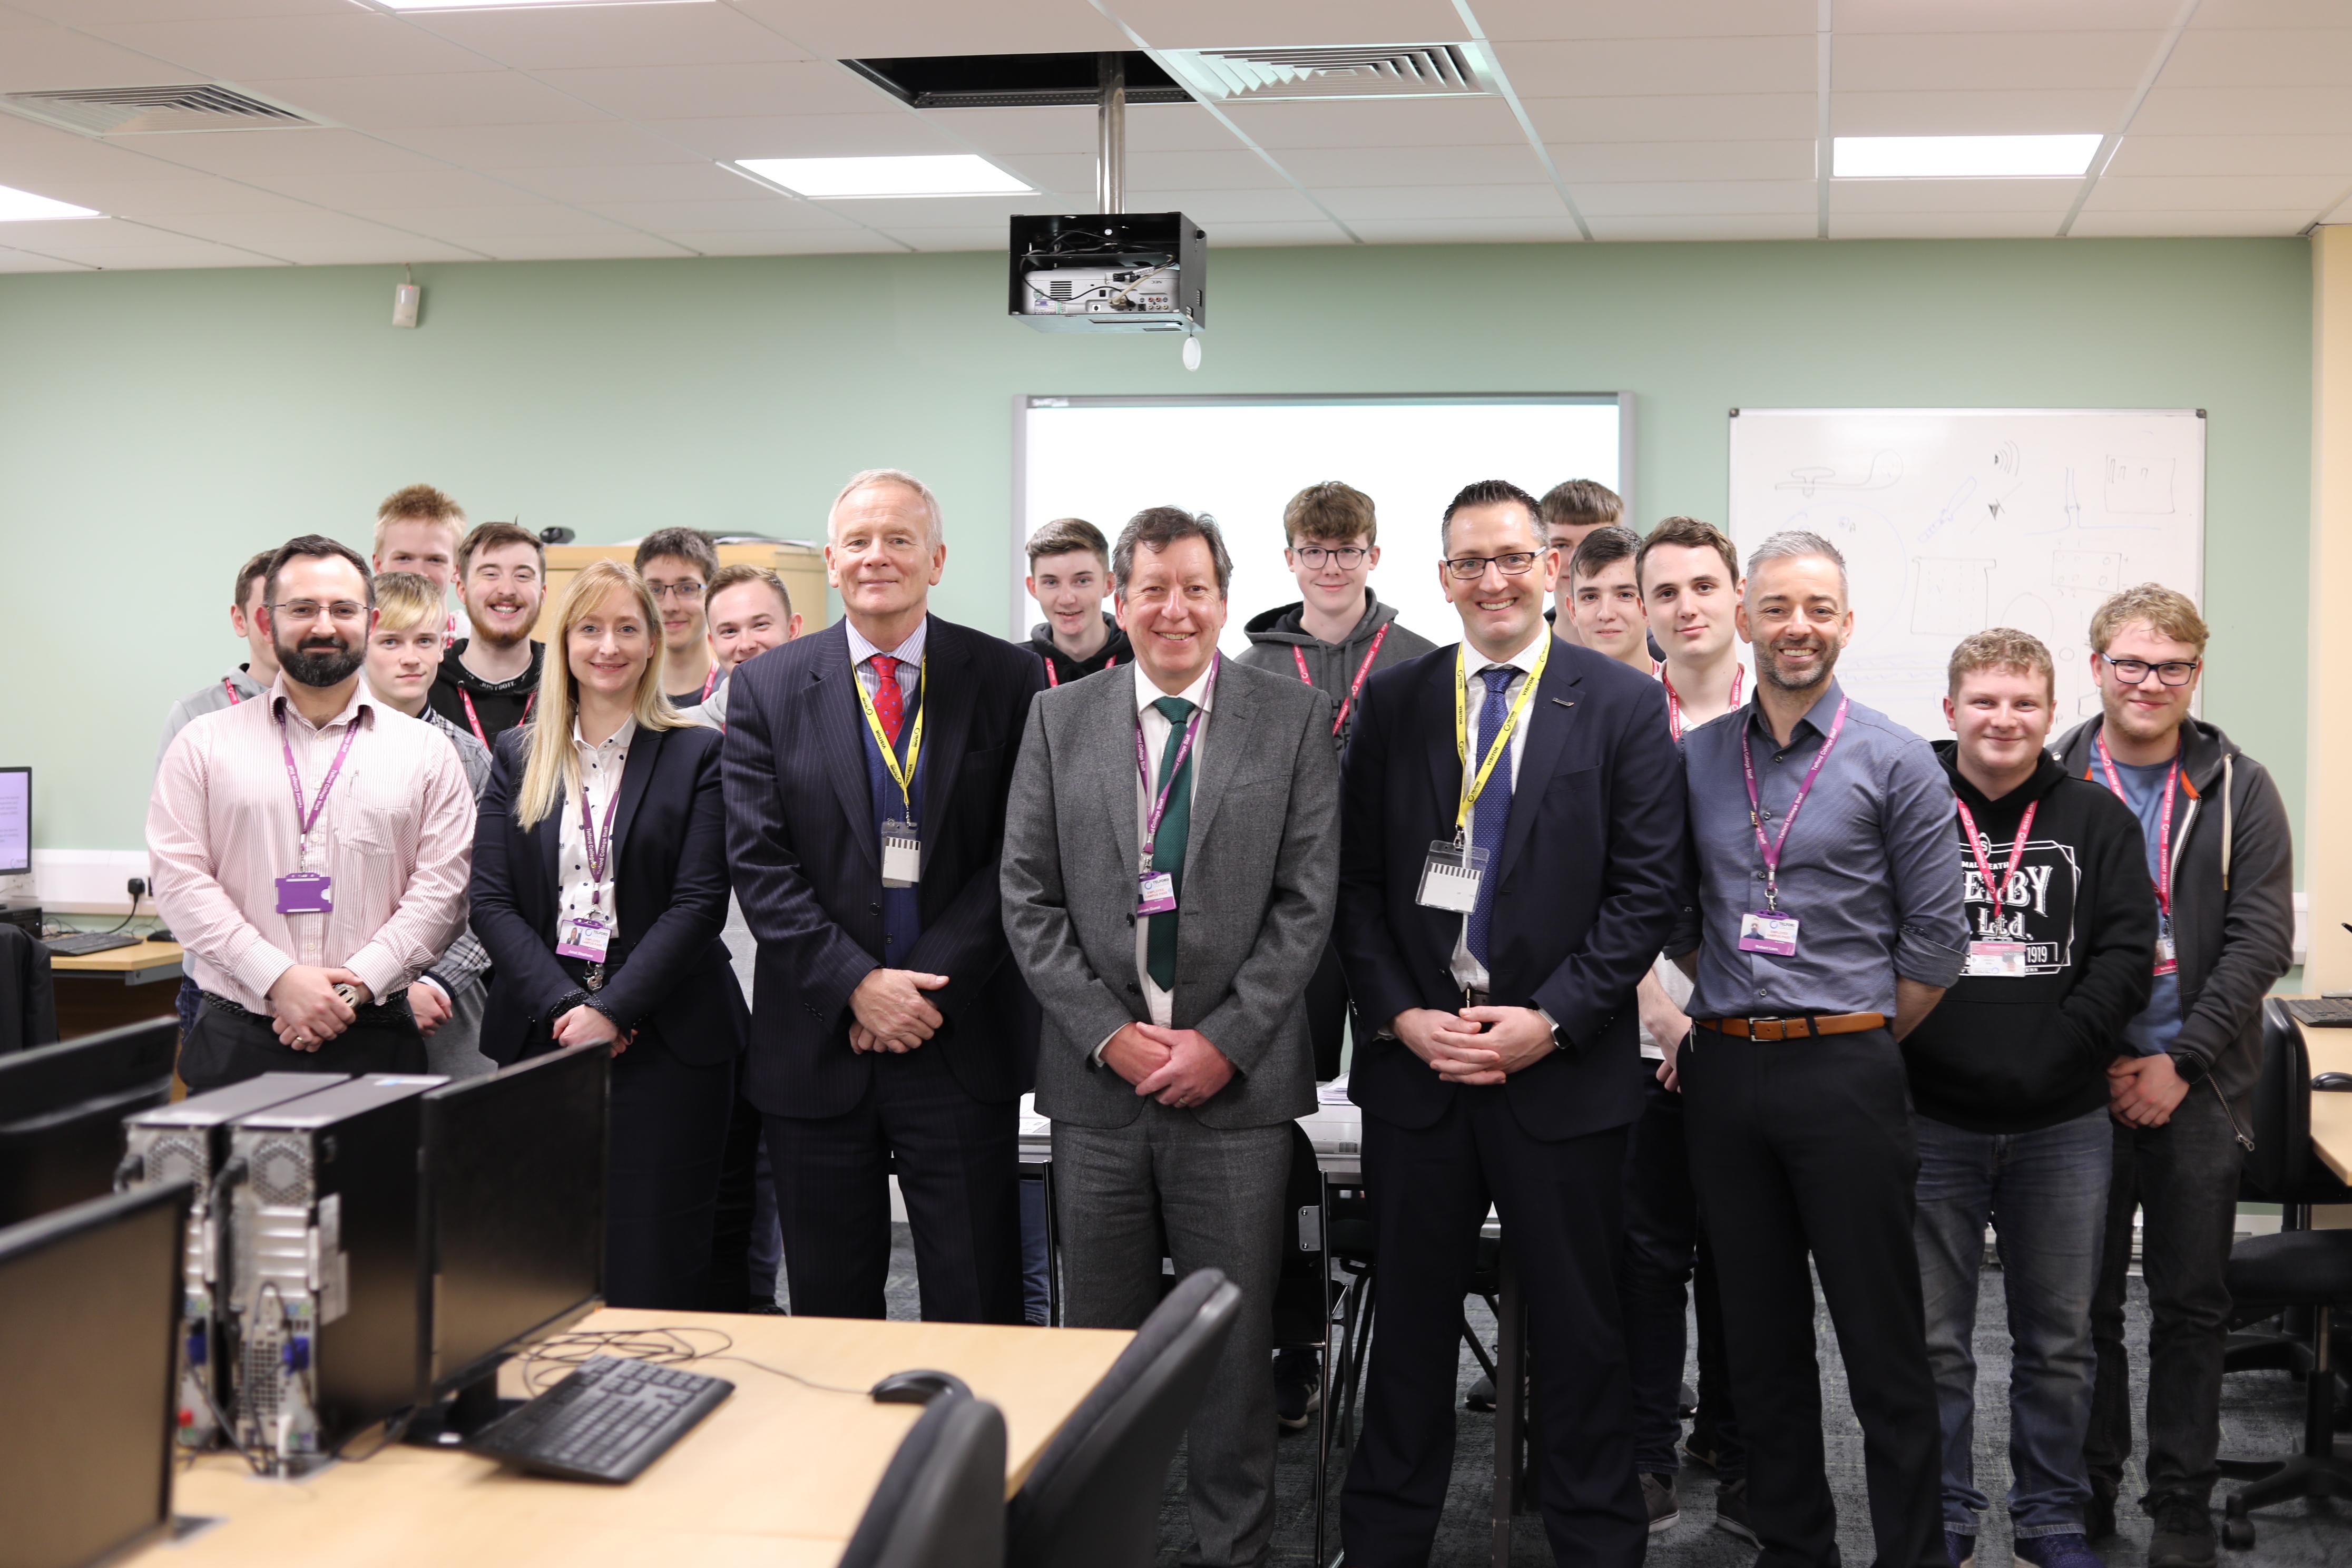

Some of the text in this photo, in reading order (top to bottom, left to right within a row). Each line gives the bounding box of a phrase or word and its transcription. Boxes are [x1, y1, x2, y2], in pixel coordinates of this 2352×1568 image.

[1363, 650, 1375, 668] STUDENT
[1522, 676, 1535, 697] VISITOR
[1337, 704, 1349, 724] STUDENT
[875, 730, 887, 750] VISITOR
[1177, 743, 1188, 763] College
[1183, 733, 1192, 745] Staff
[1811, 728, 1838, 771] Telford College Staff
[1486, 746, 1500, 766] VISITOR
[287, 765, 296, 775] Staff
[2108, 768, 2118, 786] 2019/20
[291, 775, 300, 792] College
[313, 769, 338, 811] Telford College Staff
[1150, 810, 1161, 829] College
[1779, 792, 1805, 839] Telford College Staff
[585, 827, 594, 845] Telford
[1759, 832, 1767, 845] Staff
[599, 838, 609, 857] College
[1969, 829, 1987, 869] STUDENT 2019/20
[596, 857, 605, 875] Telford
[1988, 861, 2010, 870] EATH
[2008, 854, 2018, 876] STUDENT
[1978, 907, 2034, 941] Ltd.
[2026, 945, 2048, 964] 1919
